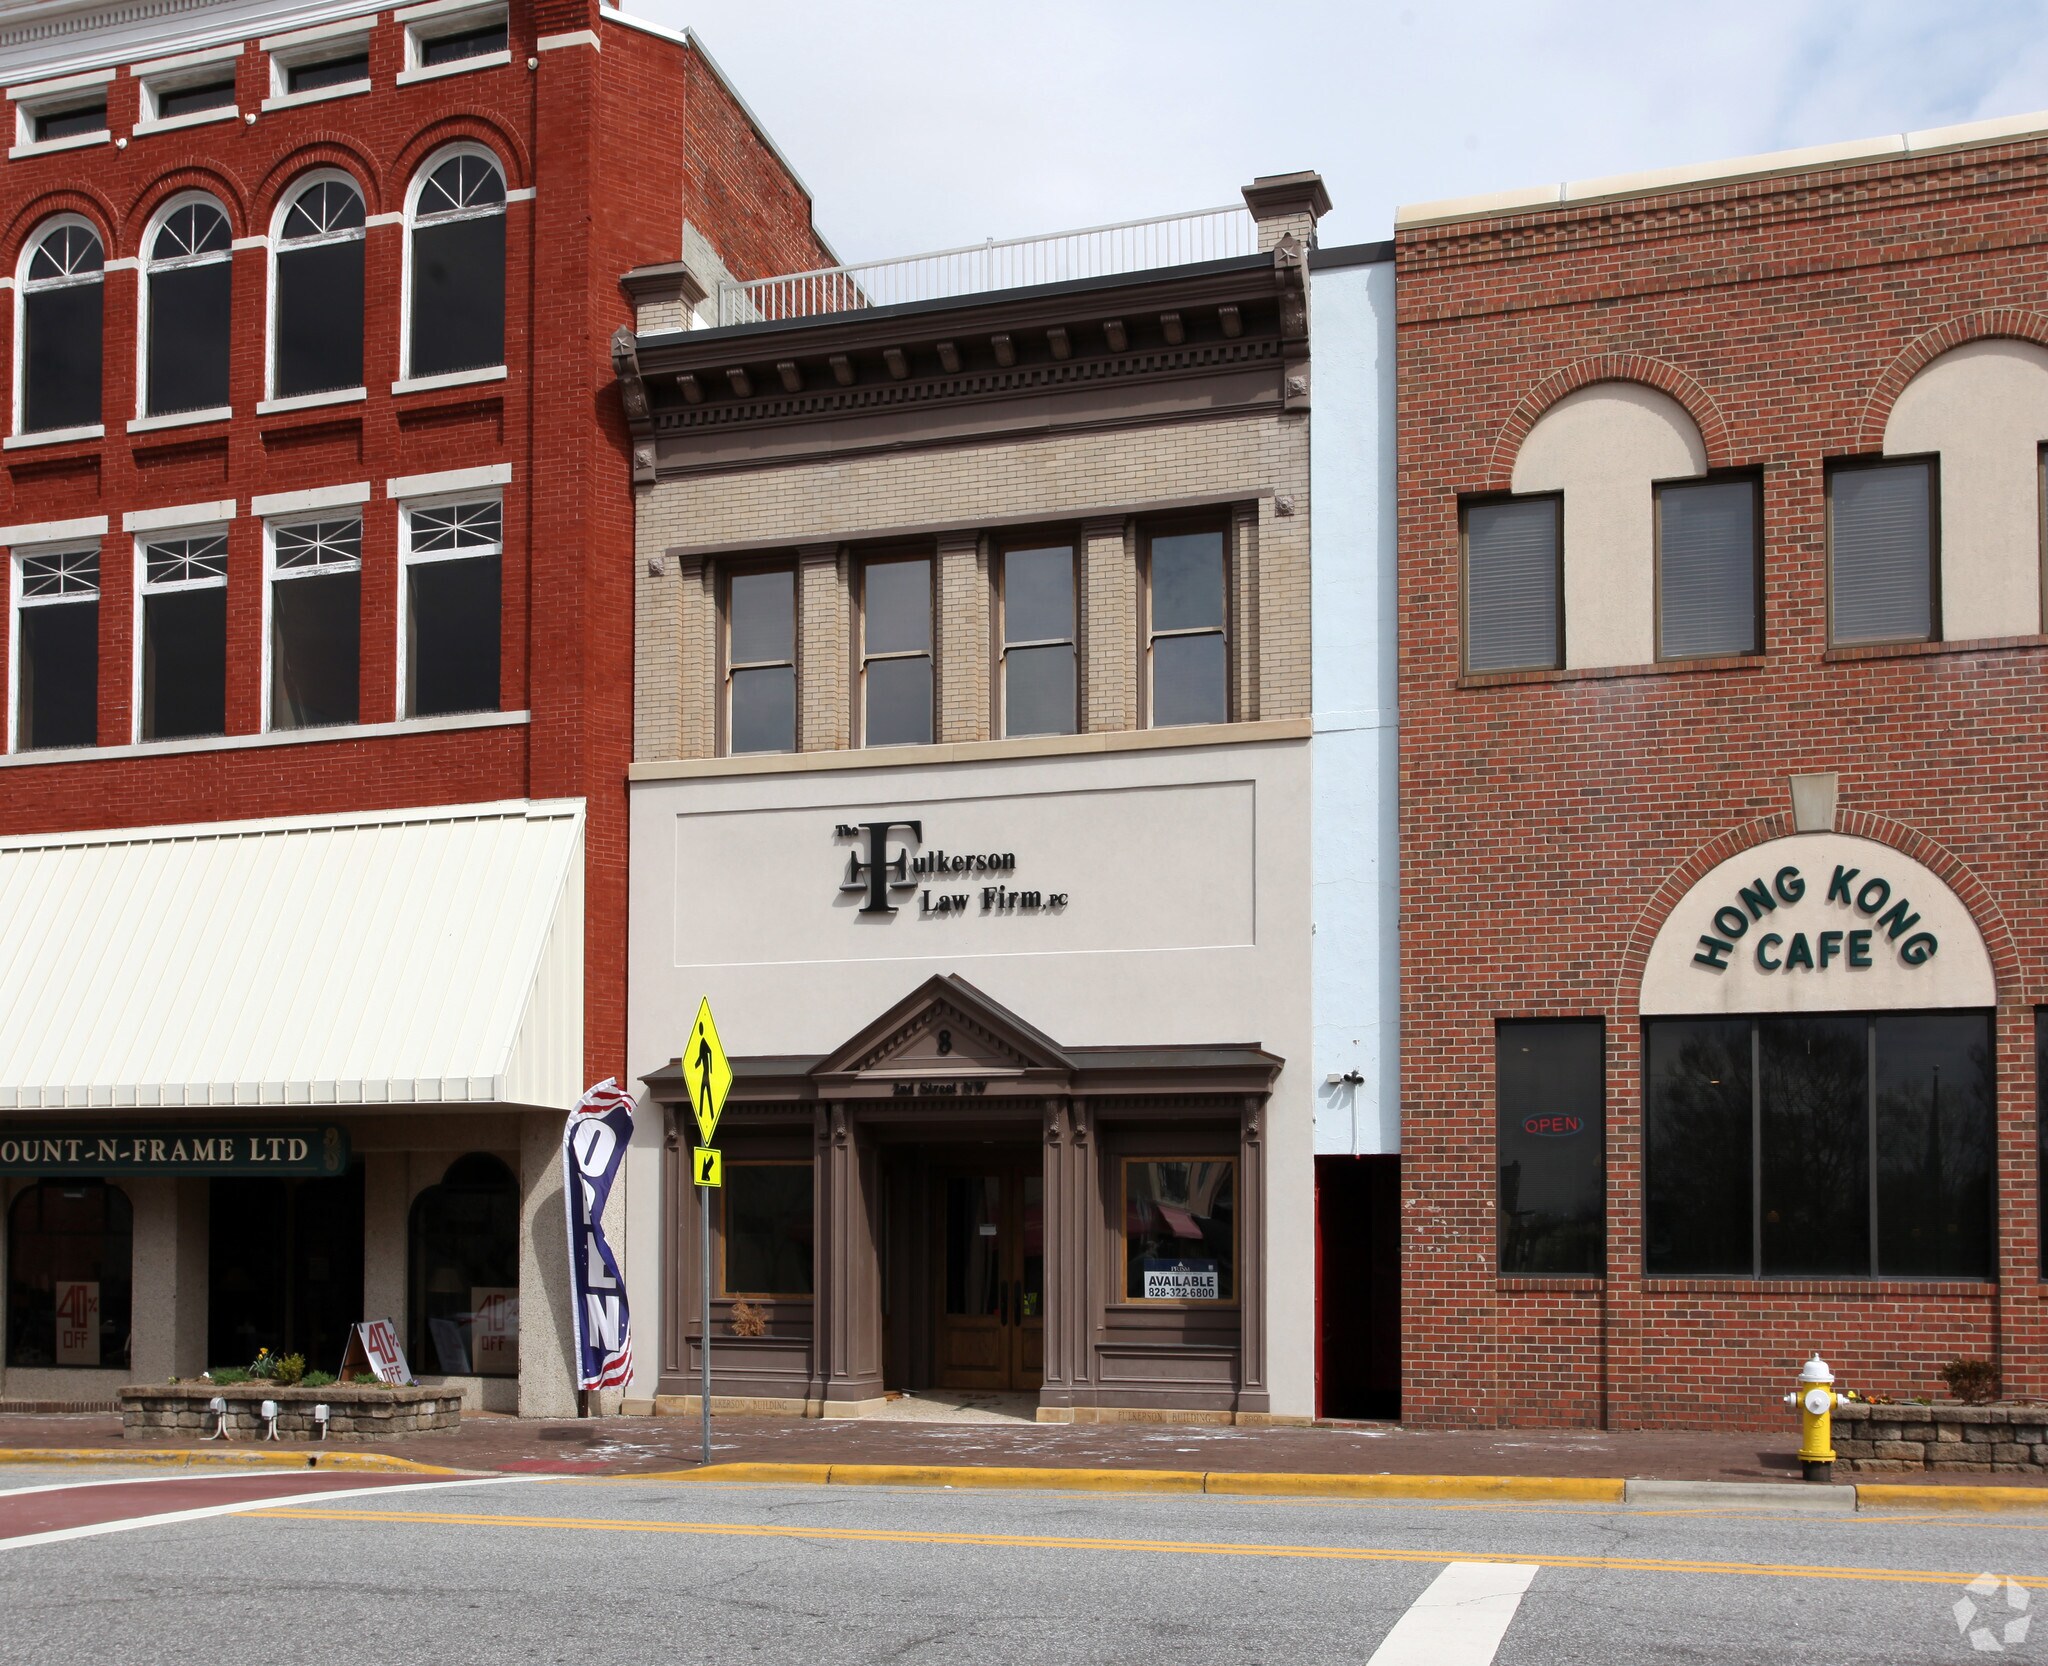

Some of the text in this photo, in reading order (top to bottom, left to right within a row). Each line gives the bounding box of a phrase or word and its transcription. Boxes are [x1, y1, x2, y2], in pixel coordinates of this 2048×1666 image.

[836, 824, 859, 837] The
[922, 889, 970, 912] Law
[1693, 864, 1938, 970] HONG KONG
[1757, 929, 1873, 970] CAFE
[938, 1029, 953, 1054] 8
[893, 1082, 915, 1096] 2nd
[918, 1081, 957, 1096] Street
[1525, 1116, 1577, 1134] OPEN
[249, 1137, 309, 1162] LTD
[1148, 1276, 1214, 1287] AVAILABLE
[1148, 1287, 1215, 1297] 828-322-6800
[57, 1285, 98, 1329] 40%
[63, 1330, 88, 1350] OFF
[368, 1322, 399, 1365] 40%
[481, 1335, 506, 1351] OFF
[381, 1365, 402, 1383] OFF
[1172, 1413, 1212, 1423] BUILDING
